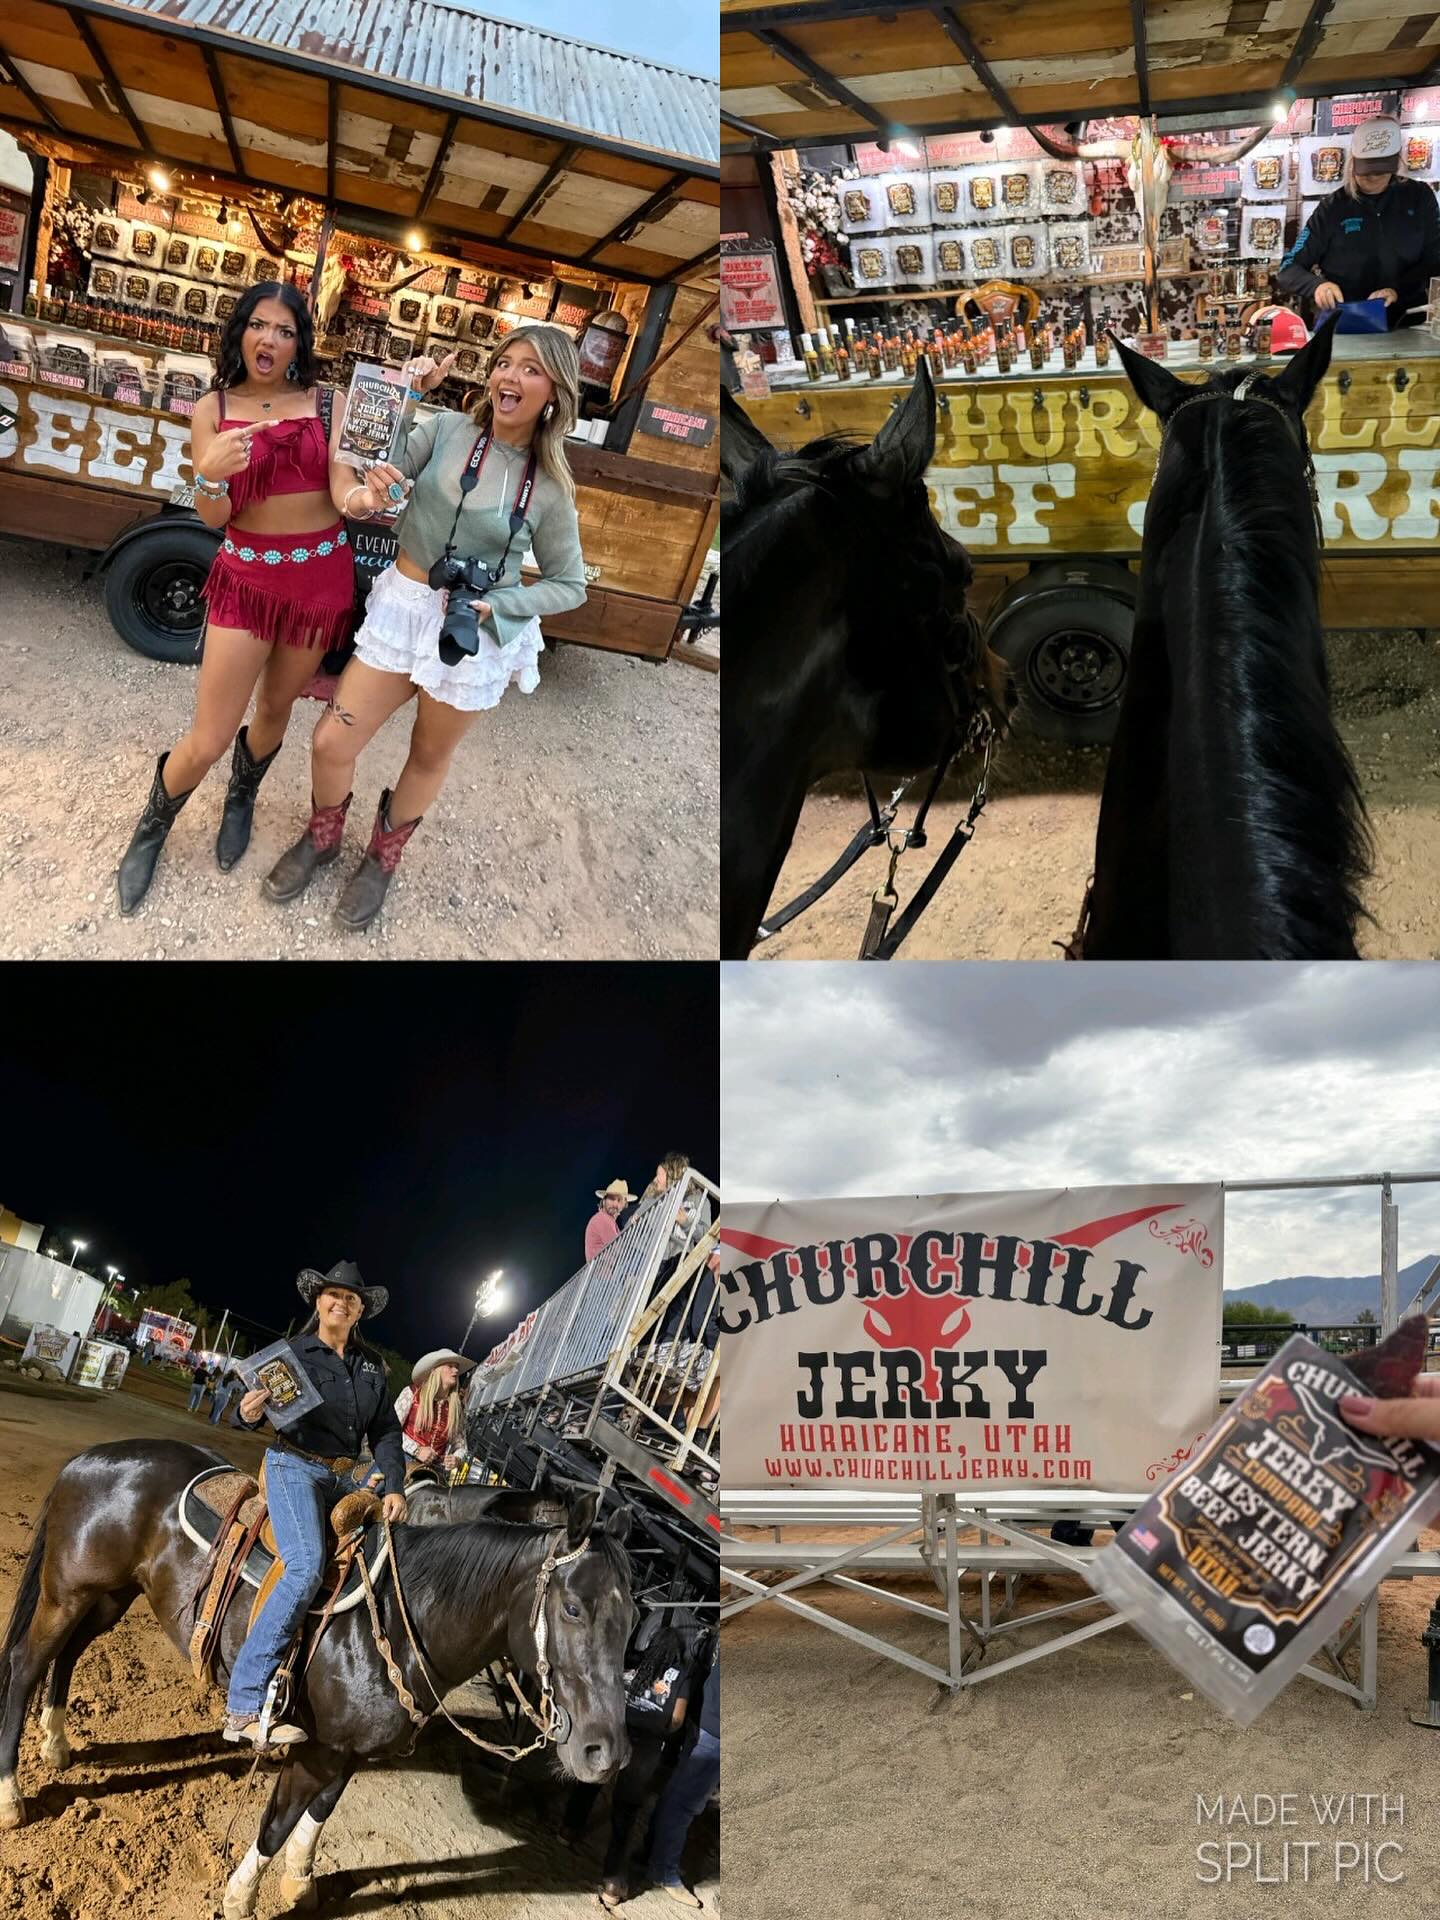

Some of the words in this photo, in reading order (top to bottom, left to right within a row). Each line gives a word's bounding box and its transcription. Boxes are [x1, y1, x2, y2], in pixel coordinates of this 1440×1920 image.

[352, 417, 389, 433] WESTERN
[357, 403, 390, 419] JERKY
[367, 430, 390, 441] JERKY
[470, 449, 483, 468] EOS
[519, 479, 532, 509] Canon
[720, 1230, 1154, 1334] CHURCHILL
[797, 1349, 1047, 1419] JERKY
[780, 1423, 966, 1457] HURRICANE,
[984, 1423, 1071, 1453] UTAH
[1241, 1457, 1324, 1530] COMPANY
[1245, 1427, 1358, 1525] JERKY
[1177, 1474, 1241, 1529] BEEF
[1237, 1519, 1323, 1603] JERKY
[1208, 1461, 1330, 1575] WESTERN
[1187, 1545, 1242, 1599] UTAH
